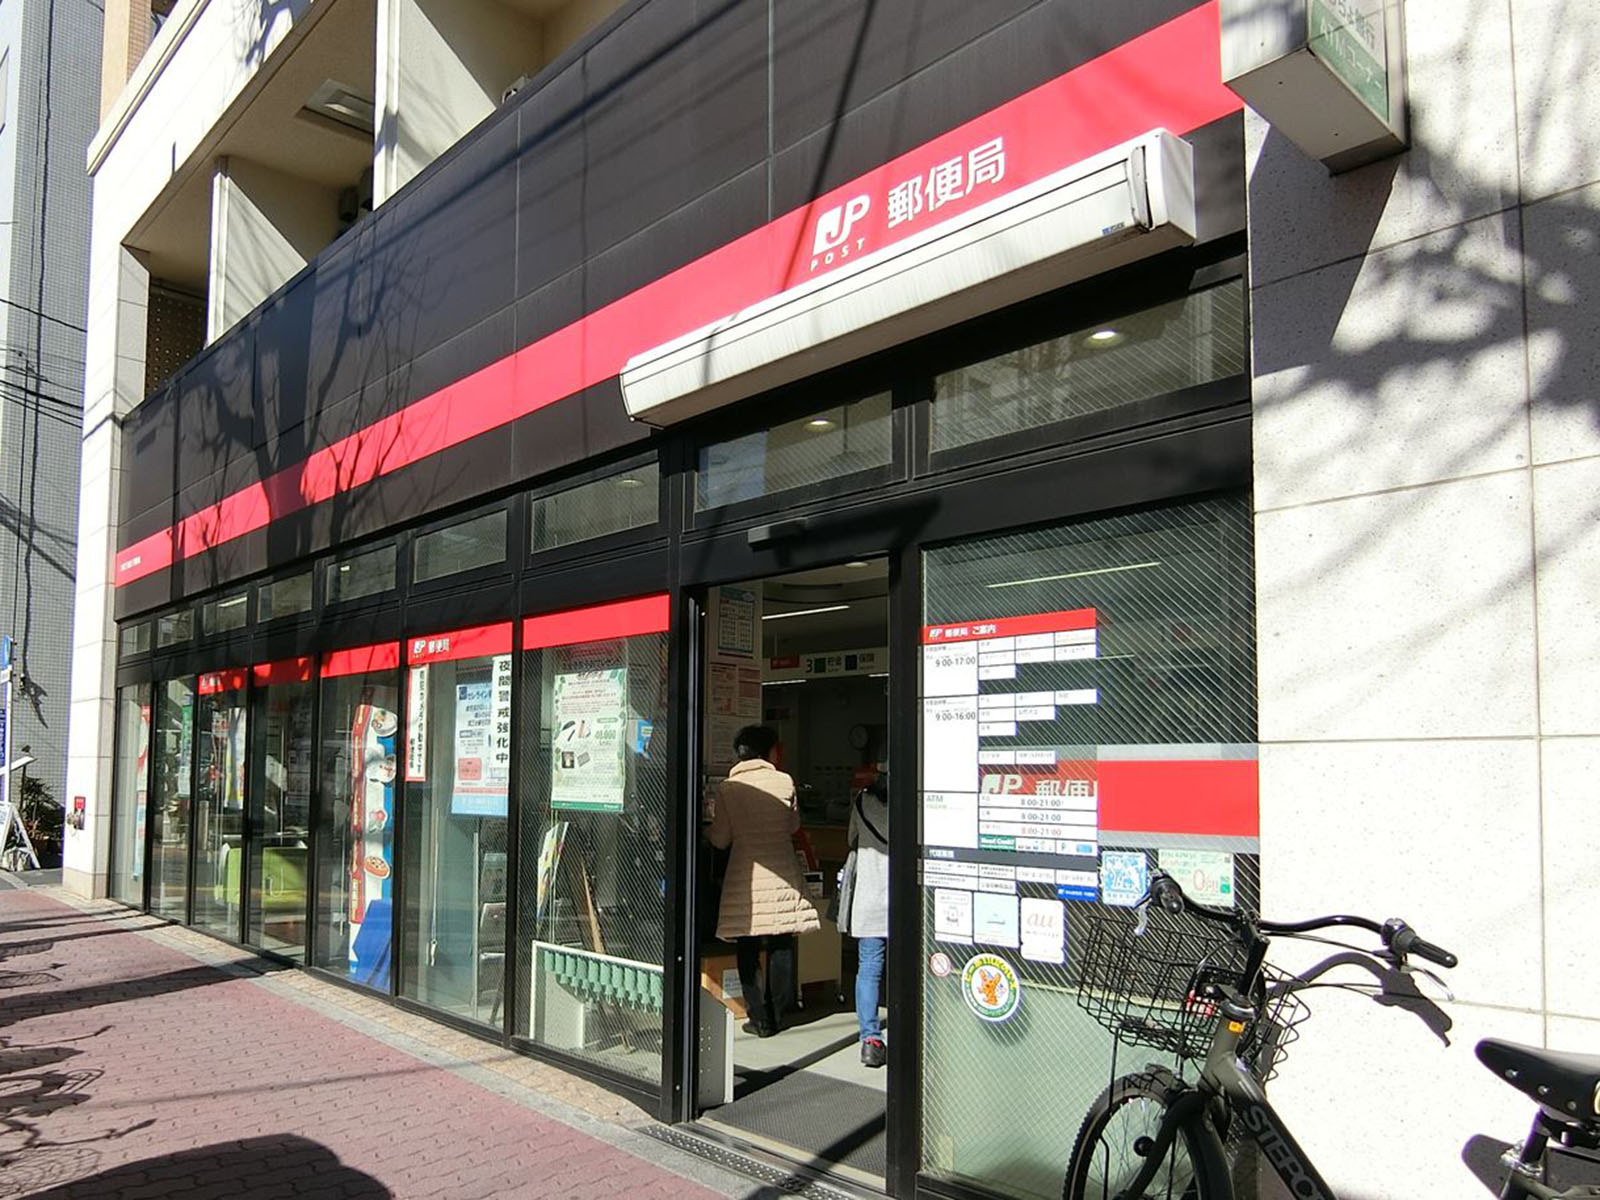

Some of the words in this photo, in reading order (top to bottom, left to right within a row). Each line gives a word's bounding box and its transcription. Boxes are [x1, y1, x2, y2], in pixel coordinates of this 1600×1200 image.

[812, 194, 871, 256] JP
[887, 136, 1006, 228] 郵便局
[809, 237, 866, 272] POST
[1036, 779, 1097, 796] 郵便
[1027, 913, 1055, 928] au
